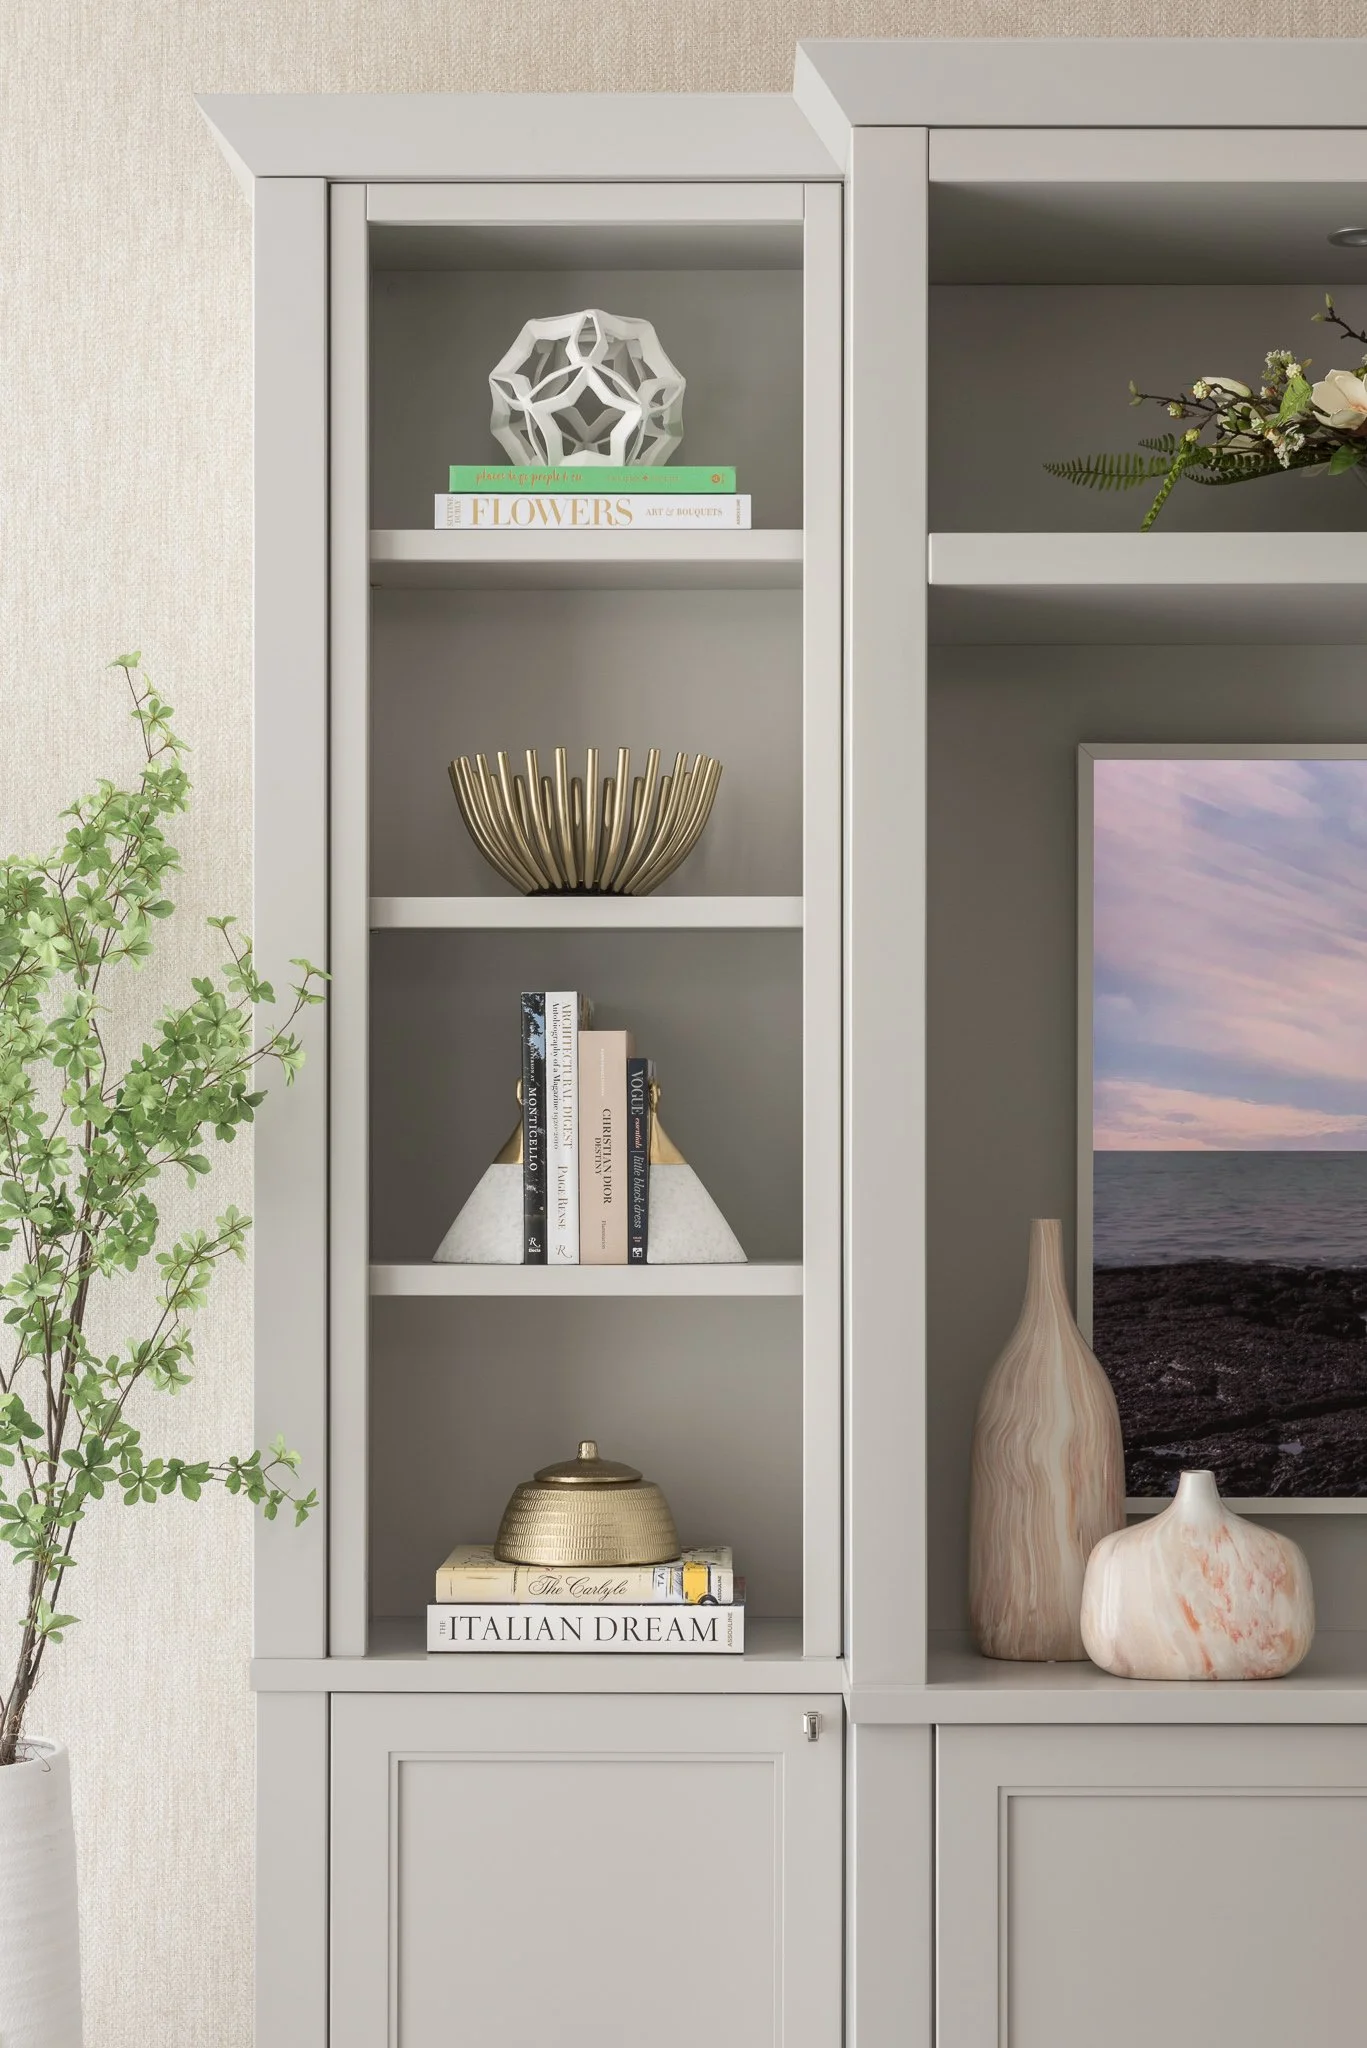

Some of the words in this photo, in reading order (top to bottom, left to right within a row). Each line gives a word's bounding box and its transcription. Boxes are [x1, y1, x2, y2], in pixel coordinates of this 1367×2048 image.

[469, 498, 633, 527] FLOWERS
[645, 508, 664, 516] ART
[665, 508, 674, 516] &
[676, 508, 723, 518] BOUQUETS
[550, 1002, 561, 1057] Autobiography
[552, 1059, 561, 1068] of
[561, 1001, 573, 1103] ARCHITECTURAL
[550, 1075, 561, 1110] Magazine
[630, 1070, 644, 1115] VOGUE
[528, 1087, 538, 1171] MONTICELLO
[562, 1106, 574, 1149] DIGEST
[602, 1109, 612, 1173] CHRISTIAN
[634, 1117, 642, 1149] essentials
[594, 1137, 602, 1176] DESTINY
[633, 1155, 645, 1176] little
[557, 1165, 569, 1195] PAIGE
[602, 1175, 612, 1204] DIOR
[633, 1177, 645, 1203] black
[557, 1197, 569, 1230] RENSE
[633, 1204, 644, 1229] dress
[528, 1575, 564, 1596] The
[565, 1576, 628, 1602] Carlyle
[448, 1616, 584, 1641] ITALIAN
[594, 1616, 719, 1642] DREAM
